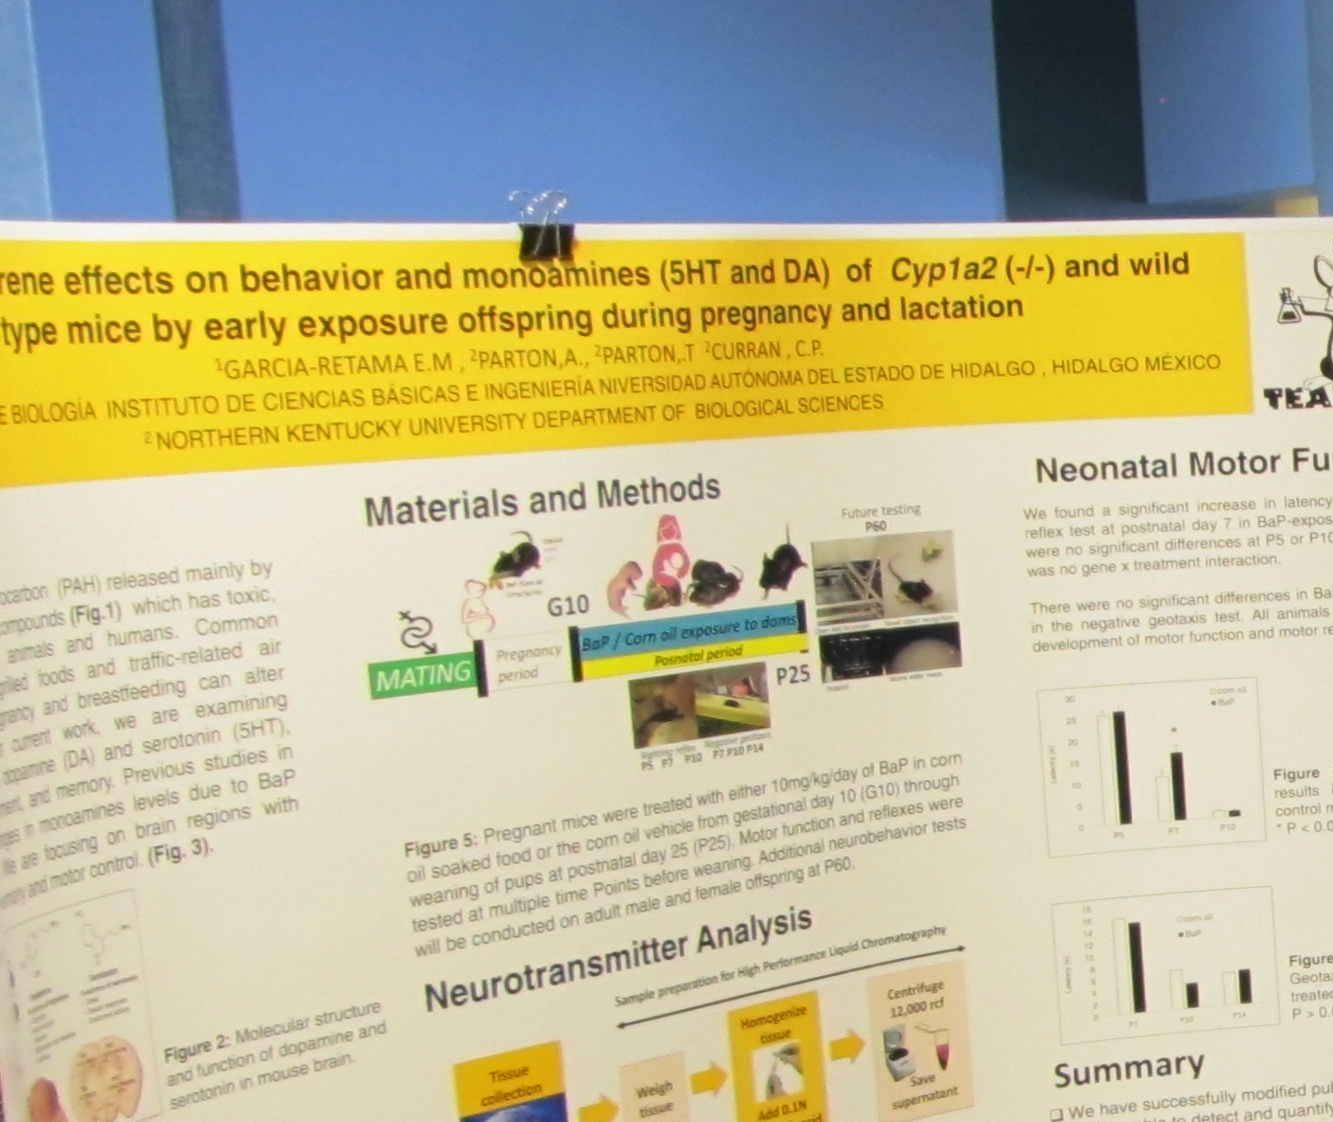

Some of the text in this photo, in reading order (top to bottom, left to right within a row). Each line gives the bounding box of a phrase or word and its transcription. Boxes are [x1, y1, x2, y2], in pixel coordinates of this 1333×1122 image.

[64, 264, 174, 295] effects
[185, 270, 228, 294] on
[240, 262, 383, 293] behavior
[396, 261, 452, 290] and
[463, 260, 650, 289] monoamines
[660, 258, 721, 291] (5HT
[731, 258, 775, 285] and
[784, 258, 829, 288] DA)
[846, 257, 871, 283] of
[891, 255, 997, 288] Cyp1a2
[1005, 254, 1055, 285] (-/-)
[1065, 252, 1119, 278] and
[1129, 251, 1189, 276] wild
[0, 294, 1023, 354] type mice by early exposure offspring during pregnancy and lactation
[106, 394, 219, 419] INSTITUTO
[226, 393, 256, 413] DE
[262, 388, 365, 412] CIENCIAS
[465, 383, 478, 402] E
[807, 367, 840, 385] DEL
[843, 364, 915, 384] ESTADO
[920, 363, 944, 380] DE
[950, 359, 1035, 378] HIDALGO
[1052, 355, 1139, 374] HIDALGO
[156, 393, 883, 450] NORTHERN KENTUCKY UNIVERSITY DEPARTMENT OF BIOLOGICAL SCIENCES
[1036, 452, 1177, 483] Neonatal
[1189, 450, 1280, 476] Motor
[365, 473, 720, 527] Materials and Methods
[841, 504, 921, 519] Future testing
[58, 559, 272, 597] (PAH) released mainly by
[547, 593, 589, 617] G10
[1030, 601, 1071, 614] There
[1076, 600, 1110, 611] were
[1116, 598, 1133, 609] no
[1139, 593, 1209, 611] significant
[1214, 591, 1290, 604] differences
[1296, 590, 1308, 600] in
[195, 614, 278, 636] Common
[580, 635, 610, 657] BaP
[624, 631, 656, 646] Corn
[660, 627, 677, 642] oil
[680, 622, 740, 640] exposure
[744, 619, 758, 631] to
[496, 645, 561, 662] Pregnancy
[706, 644, 743, 663] period
[376, 659, 471, 691] MATING
[498, 666, 538, 685] period
[776, 663, 810, 685] P25
[1273, 768, 1320, 783] Figure
[425, 906, 812, 1012] Neurotransmitter Analysis
[887, 981, 944, 1000] Centrifuge
[163, 1001, 381, 1064] Figure 2: Molecular structure
[489, 1066, 529, 1082] Tissue
[1054, 1054, 1204, 1089] Summary
